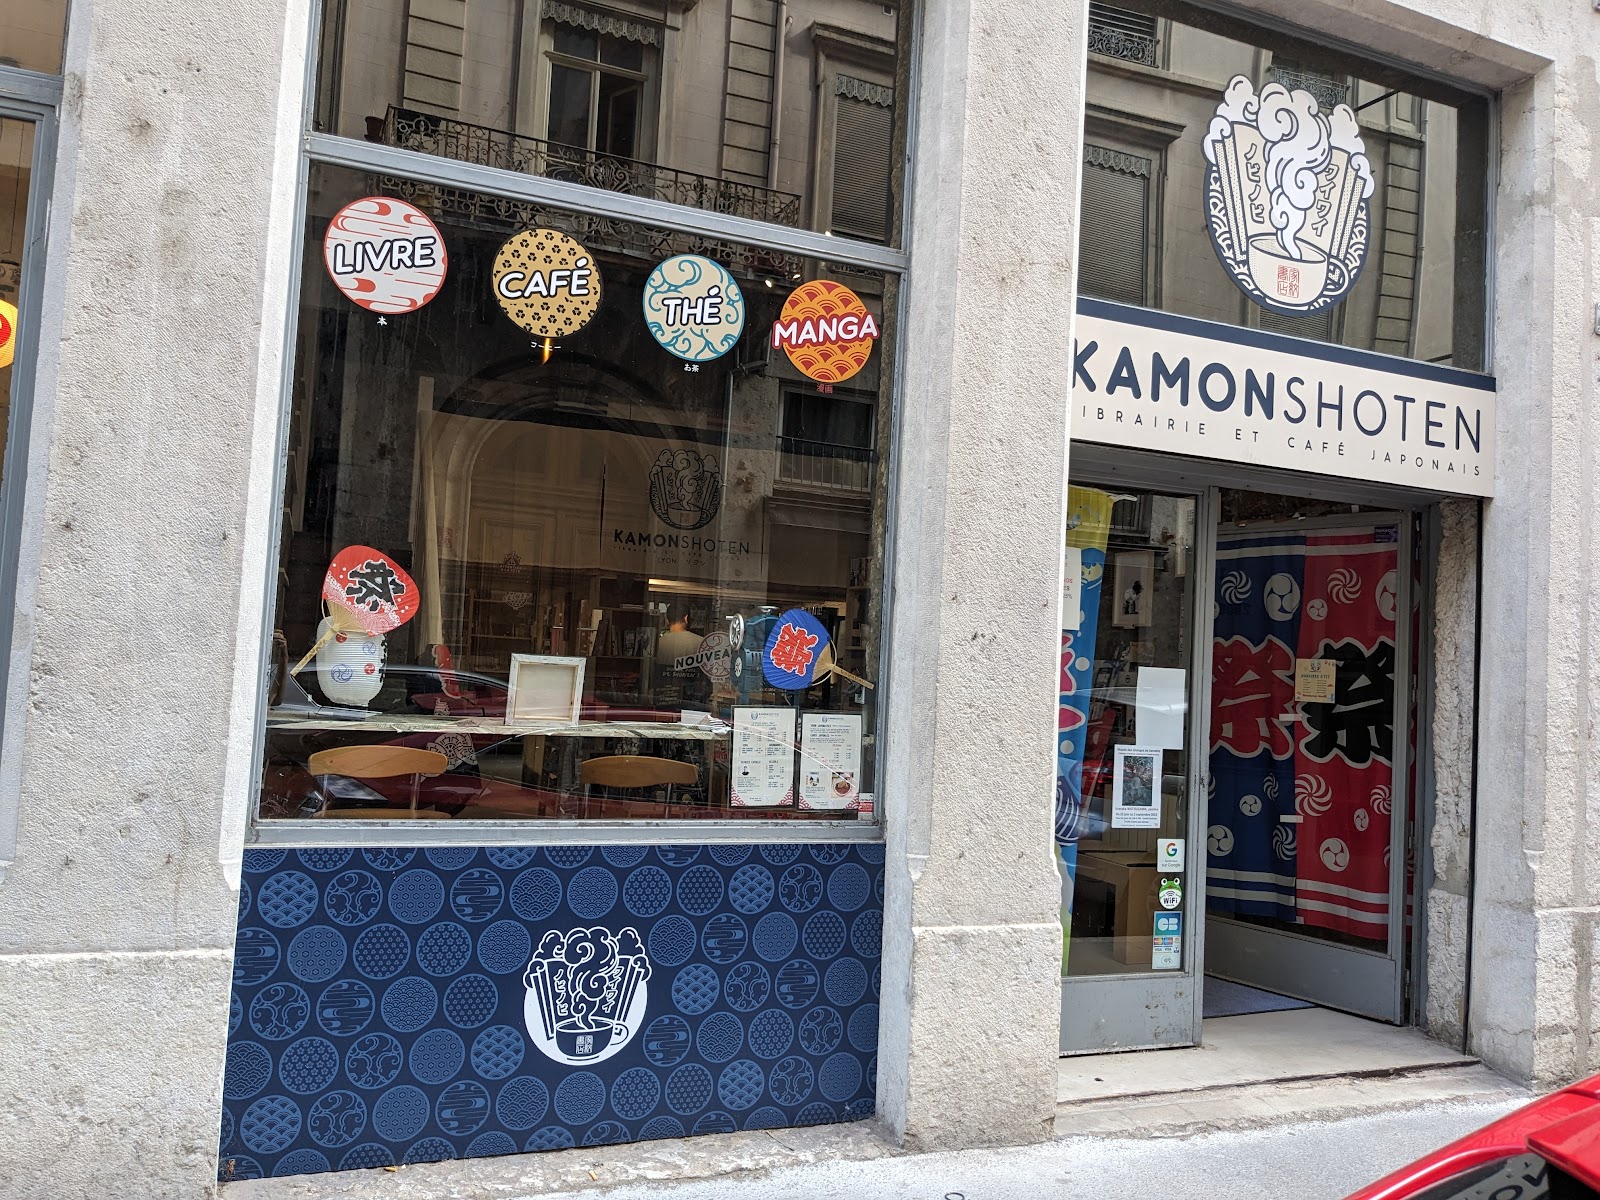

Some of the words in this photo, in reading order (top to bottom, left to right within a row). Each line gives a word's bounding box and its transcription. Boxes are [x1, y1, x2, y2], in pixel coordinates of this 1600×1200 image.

[334, 236, 436, 275] LIVRE
[498, 257, 592, 300] CAFÉ
[376, 315, 388, 326] 本
[662, 285, 723, 327] THÉ
[773, 312, 879, 348] MANGA
[683, 363, 700, 373] お茶
[816, 383, 834, 394] 漫画
[1073, 338, 1480, 453] KAMONSHOTEN
[1235, 428, 1259, 443] ET
[1287, 437, 1346, 456] CAFÉ
[1371, 451, 1481, 477] JAPONAIS
[614, 529, 749, 554] KAMONSHOTEN
[1163, 897, 1178, 905] WiFi
